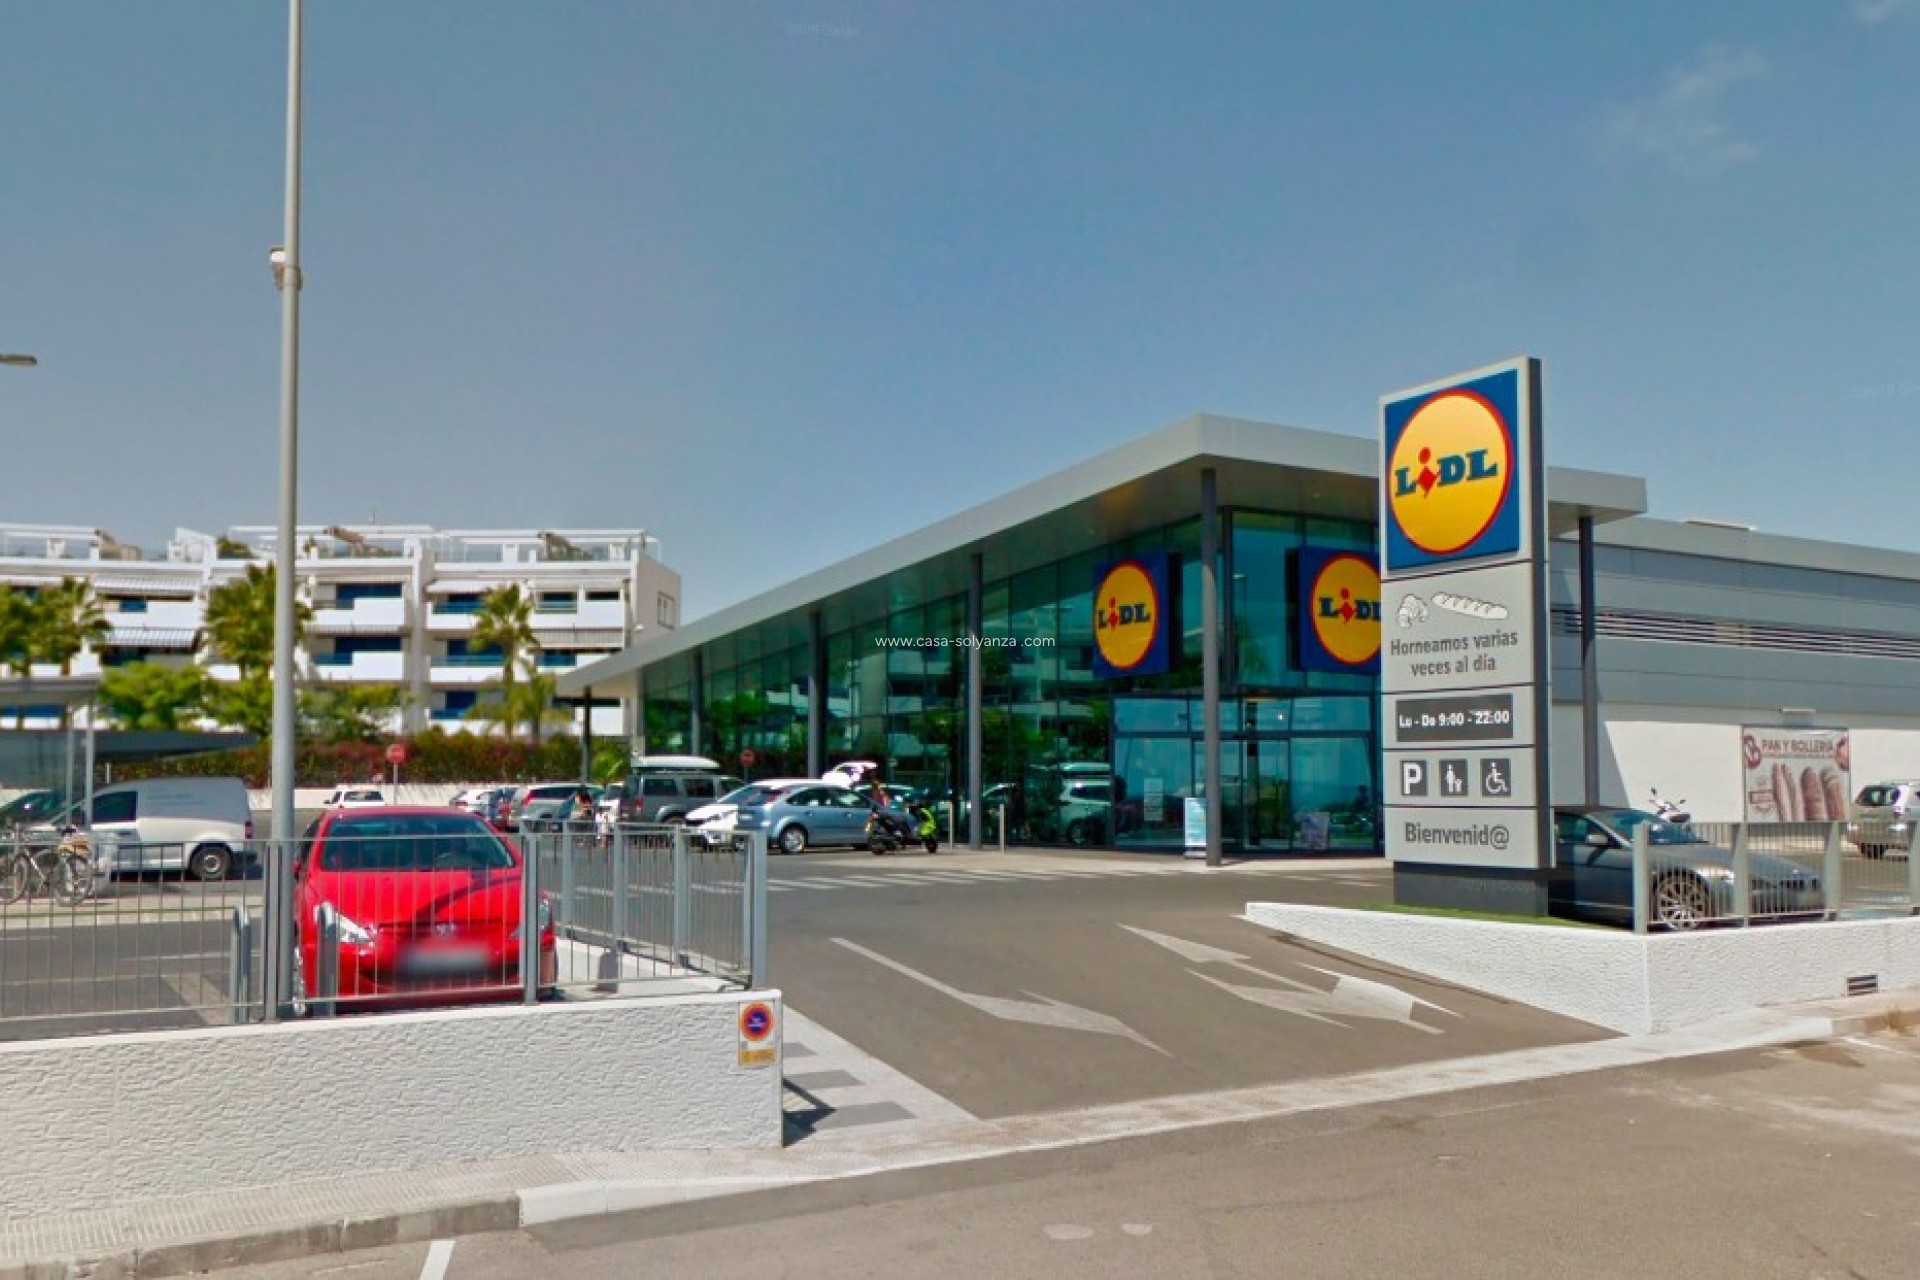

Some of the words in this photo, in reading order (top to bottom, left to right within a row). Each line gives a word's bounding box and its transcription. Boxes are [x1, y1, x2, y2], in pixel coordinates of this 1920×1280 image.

[1390, 637, 1469, 656] Horneamos
[1474, 629, 1518, 648] varias
[1411, 660, 1450, 677] veces
[1455, 655, 1468, 673] al
[1473, 654, 1496, 672] día
[1439, 712, 1464, 726] 9:00
[1402, 762, 1423, 794] P
[1404, 822, 1510, 849] Bienvenid@
